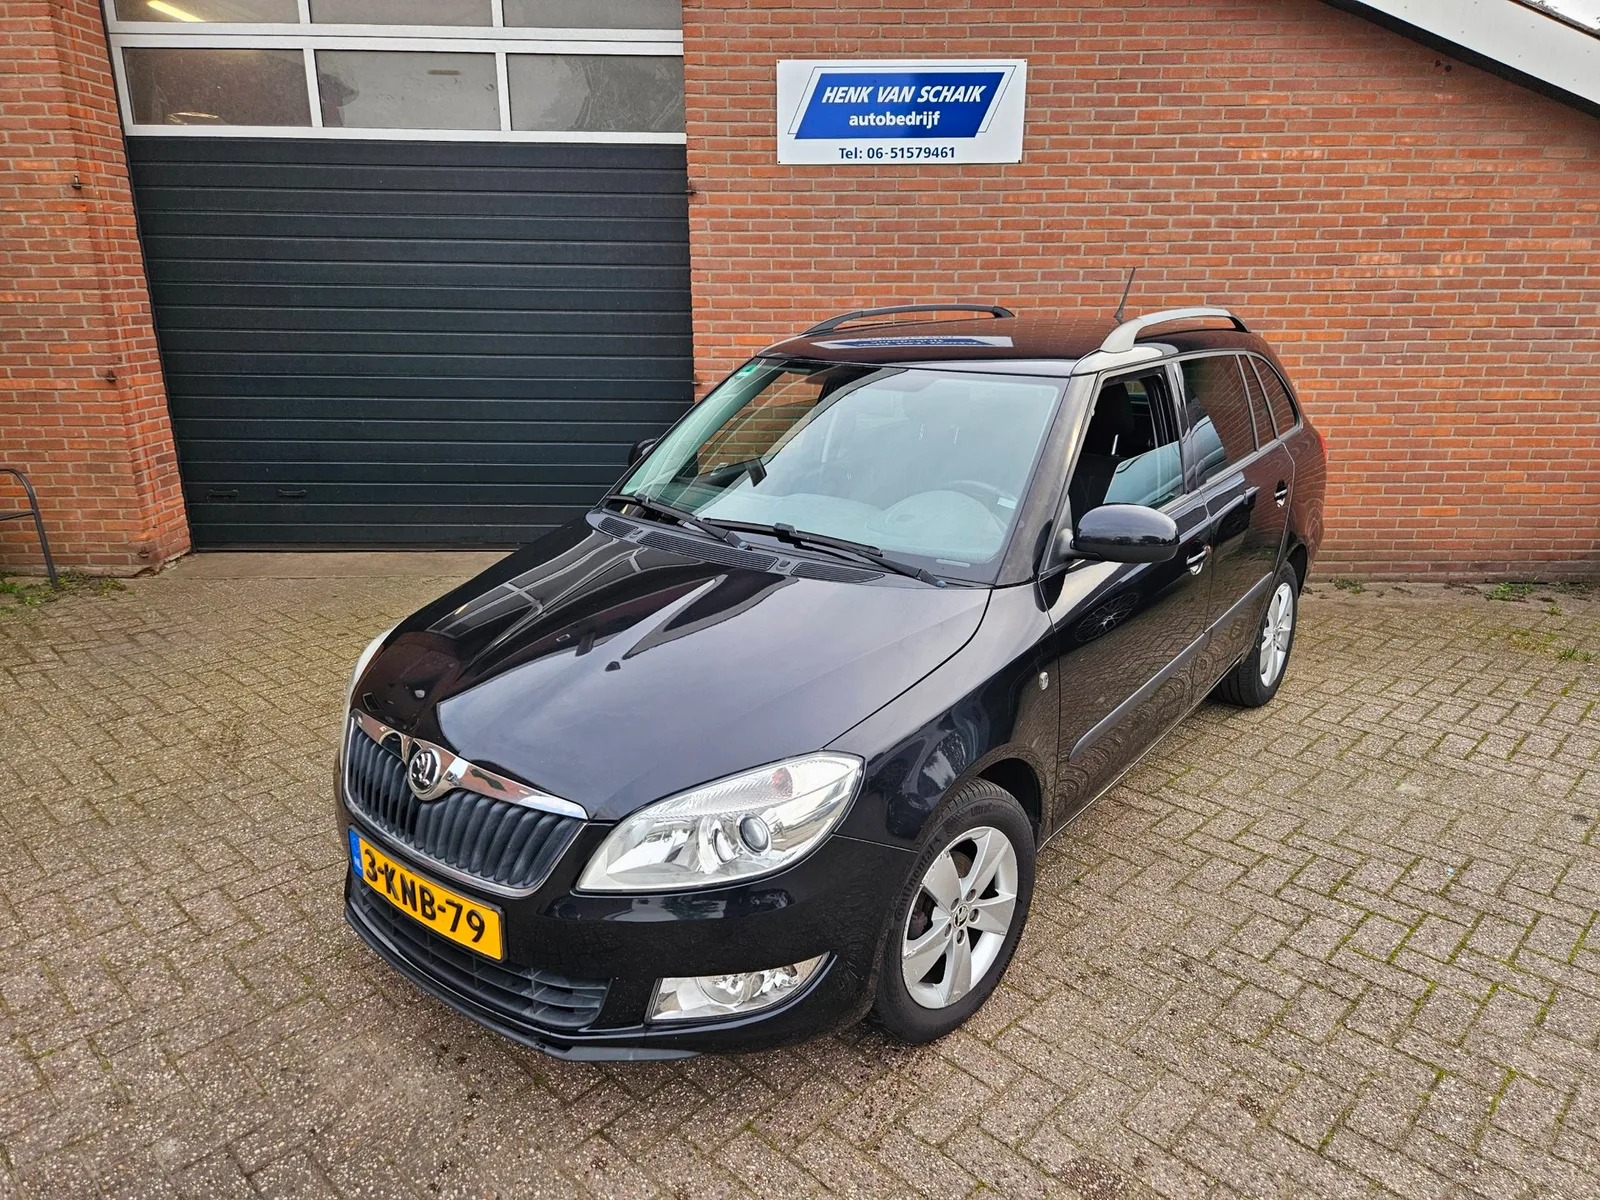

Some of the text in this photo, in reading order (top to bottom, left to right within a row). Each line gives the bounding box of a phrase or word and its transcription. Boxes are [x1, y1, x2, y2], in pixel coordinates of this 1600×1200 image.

[821, 85, 987, 104] HENK VAN SCHAIK
[849, 110, 941, 129] autobedrijf
[838, 146, 956, 160] Tel: 06-51579461
[364, 848, 486, 943] 3-KNB-79
